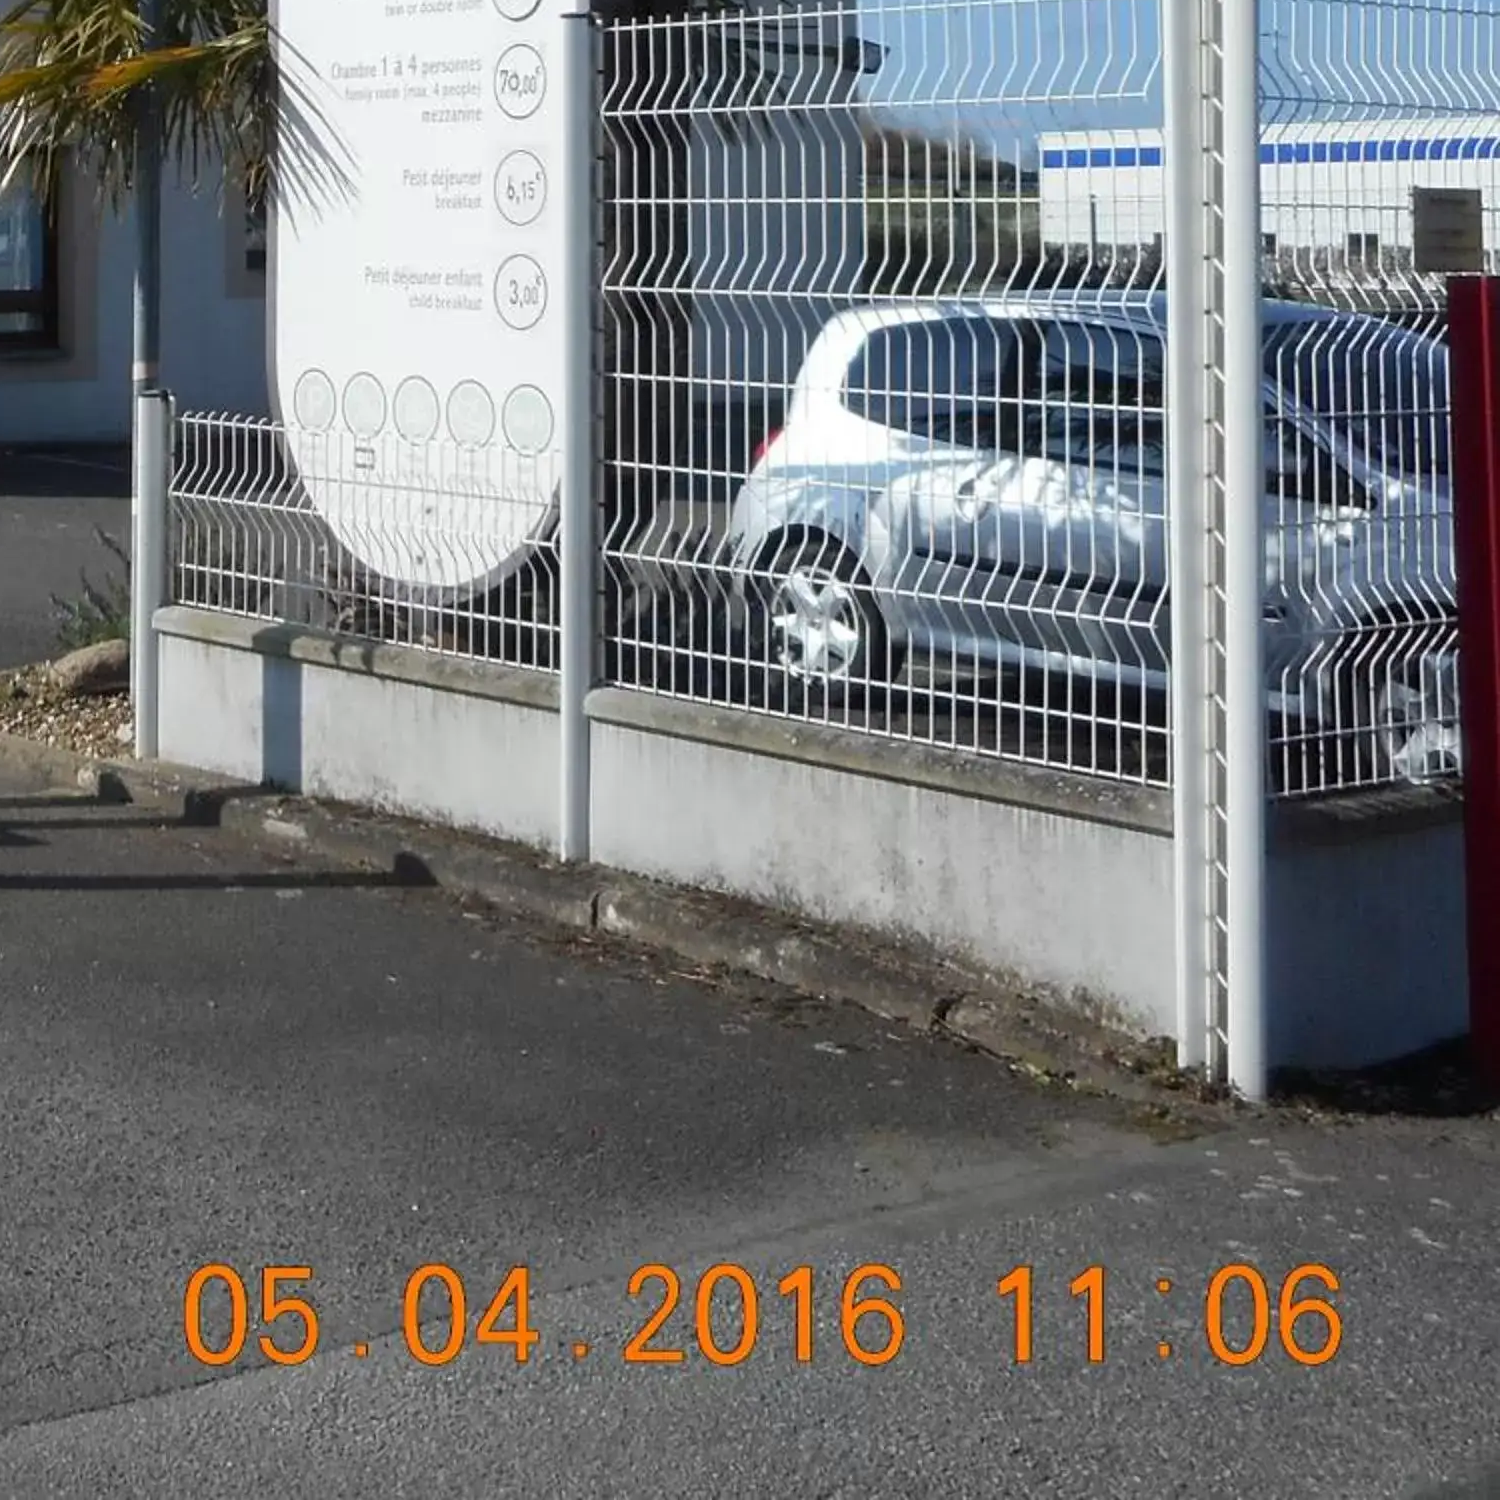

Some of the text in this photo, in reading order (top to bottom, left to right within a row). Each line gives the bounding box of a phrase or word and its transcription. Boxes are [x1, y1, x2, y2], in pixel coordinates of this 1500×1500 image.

[331, 63, 377, 80] Chambre
[381, 56, 388, 77] 1
[407, 54, 418, 75] 4
[422, 57, 482, 76] personnes
